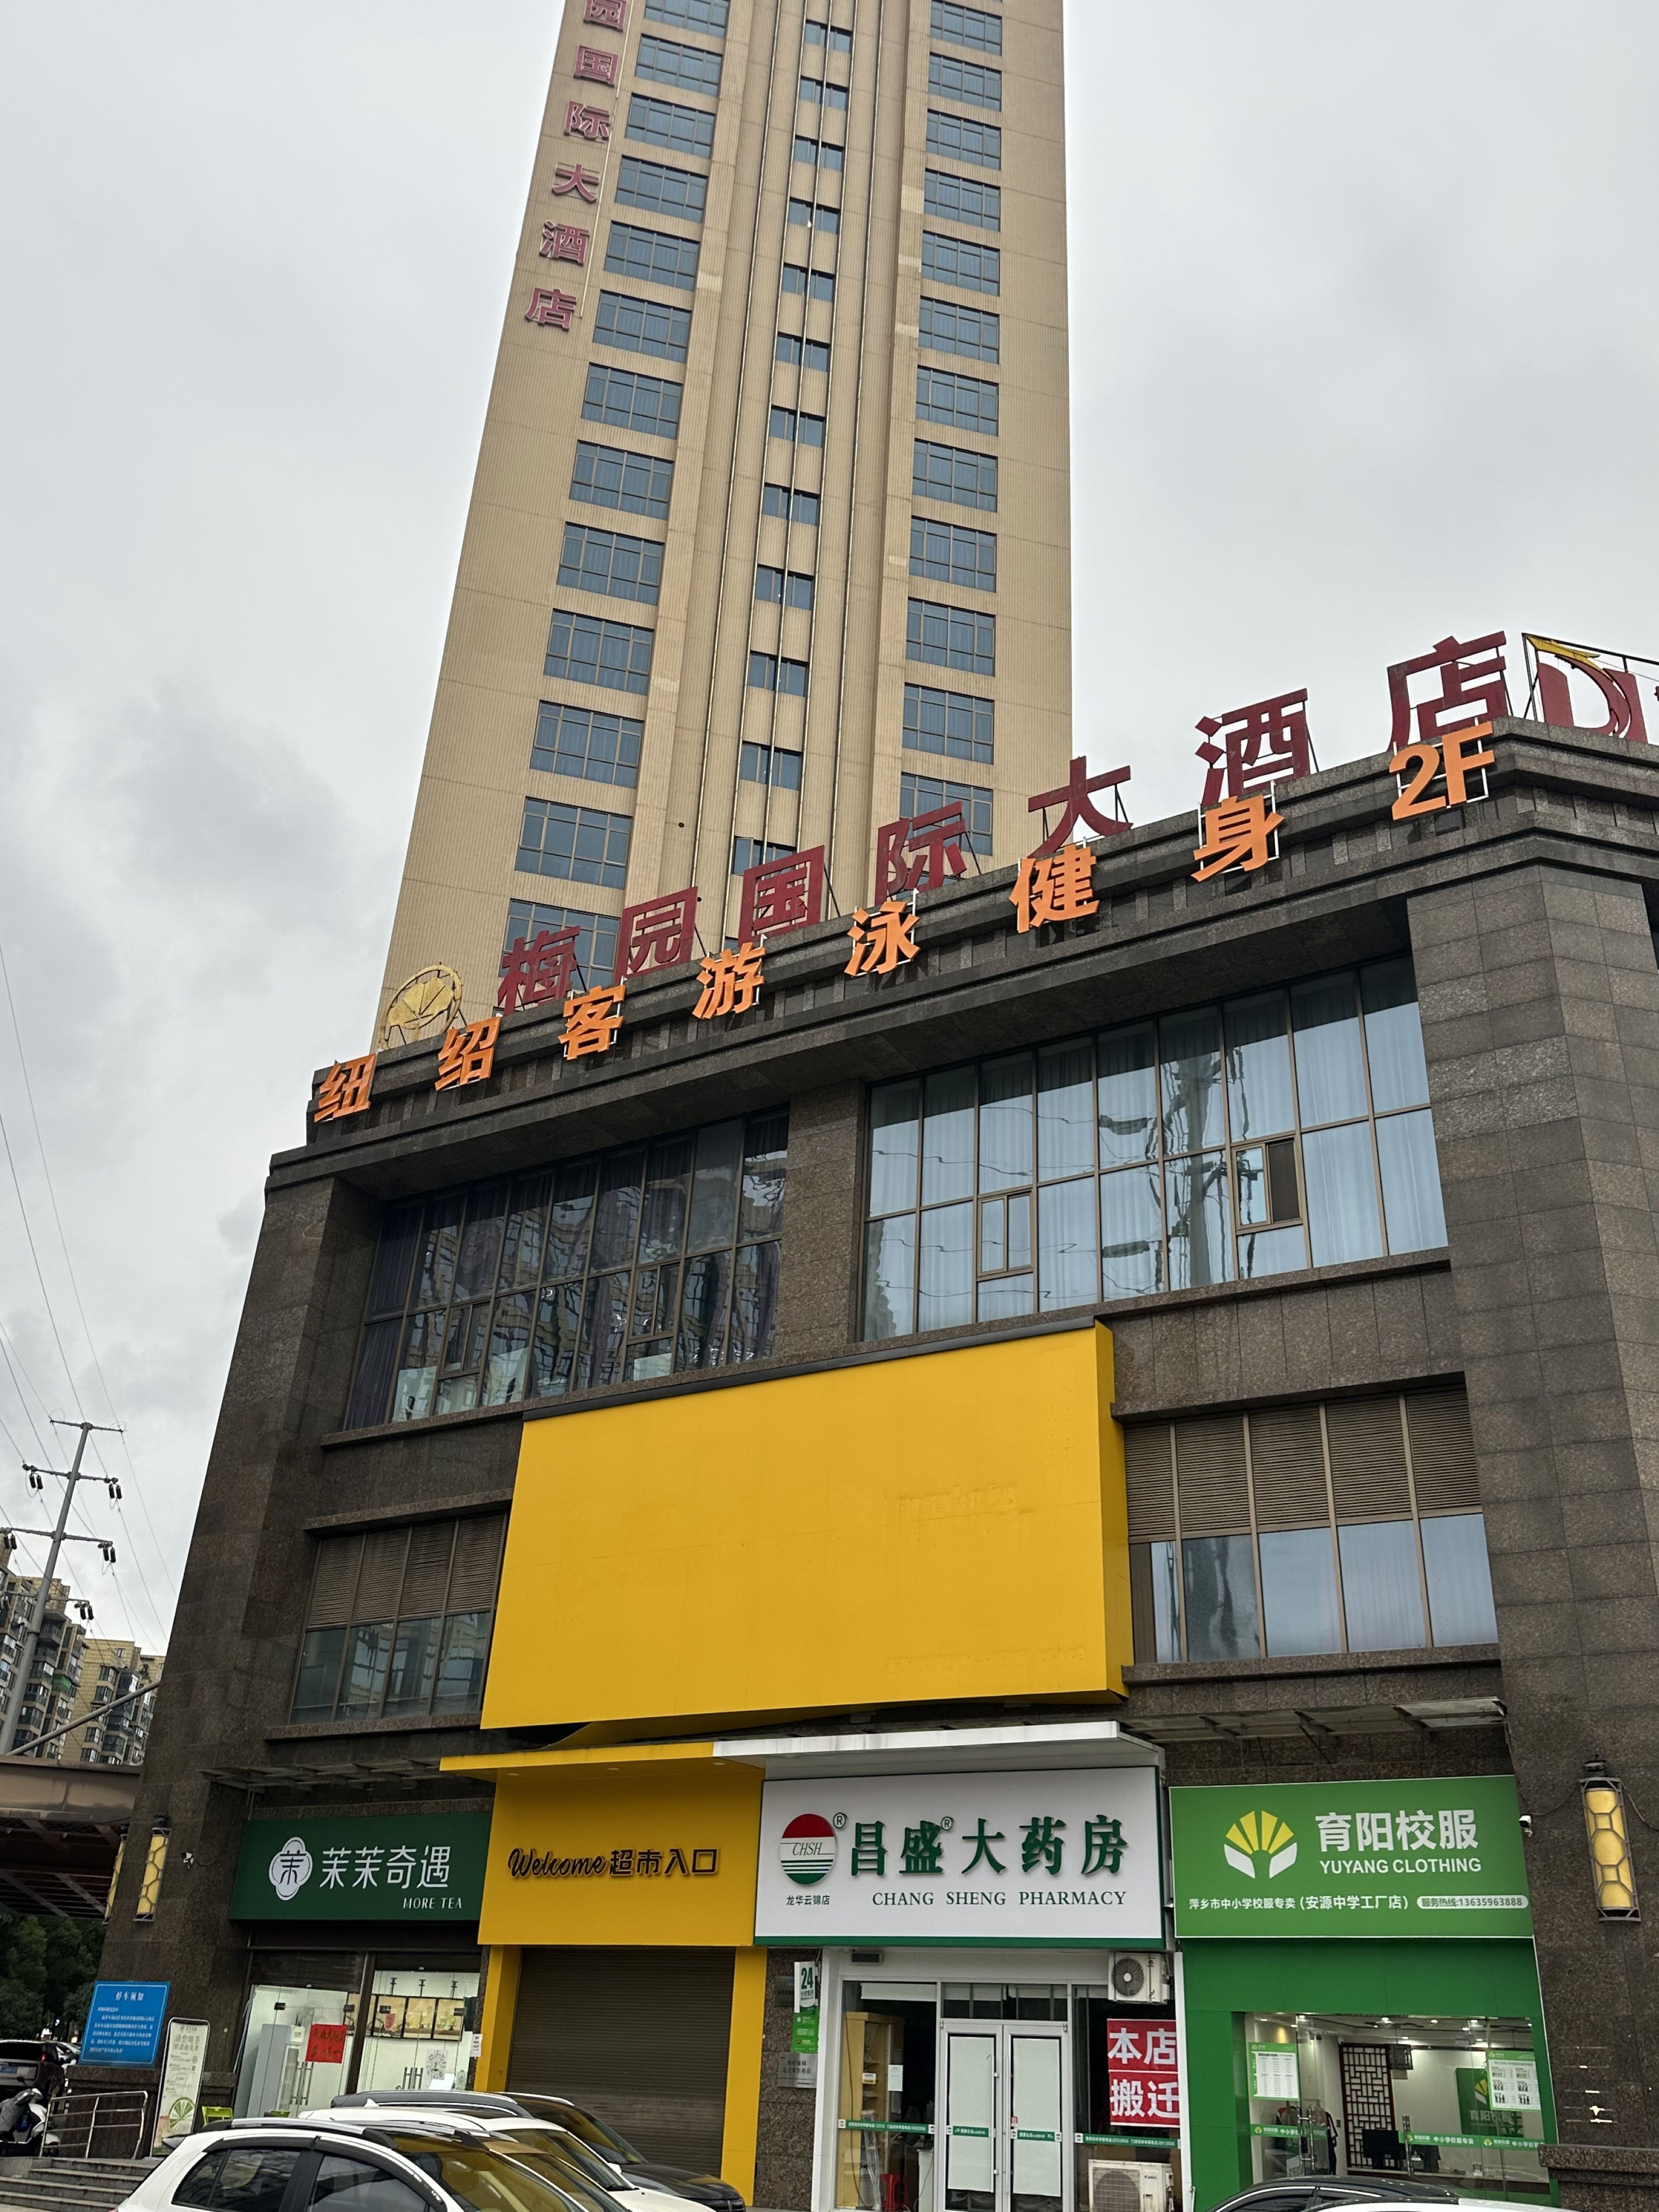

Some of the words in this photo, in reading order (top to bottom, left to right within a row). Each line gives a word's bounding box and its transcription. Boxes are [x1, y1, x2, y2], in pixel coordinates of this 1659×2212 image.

[498, 630, 1506, 1015] 梅园国际大酒店
[1315, 1809, 1478, 1852] 育阳校服
[792, 1842, 823, 1856] CHSH
[319, 1845, 451, 1889] 茉茉奇遇
[508, 1848, 606, 1877] Welcome
[610, 1848, 719, 1875] 超市入口
[1319, 1859, 1389, 1874] YUYANG
[1393, 1858, 1482, 1873] CLOTHING
[403, 1898, 435, 1909] MORE
[441, 1897, 462, 1909] TEA
[786, 1895, 830, 1906] 龙华云锦店
[872, 1892, 935, 1906] CHANG
[946, 1892, 1006, 1906] SHENG
[1018, 1891, 1127, 1906] PHARMACY
[801, 1967, 813, 1989] 24
[1107, 2027, 1177, 2065] 本店
[1109, 2079, 1180, 2118] 搬迁
